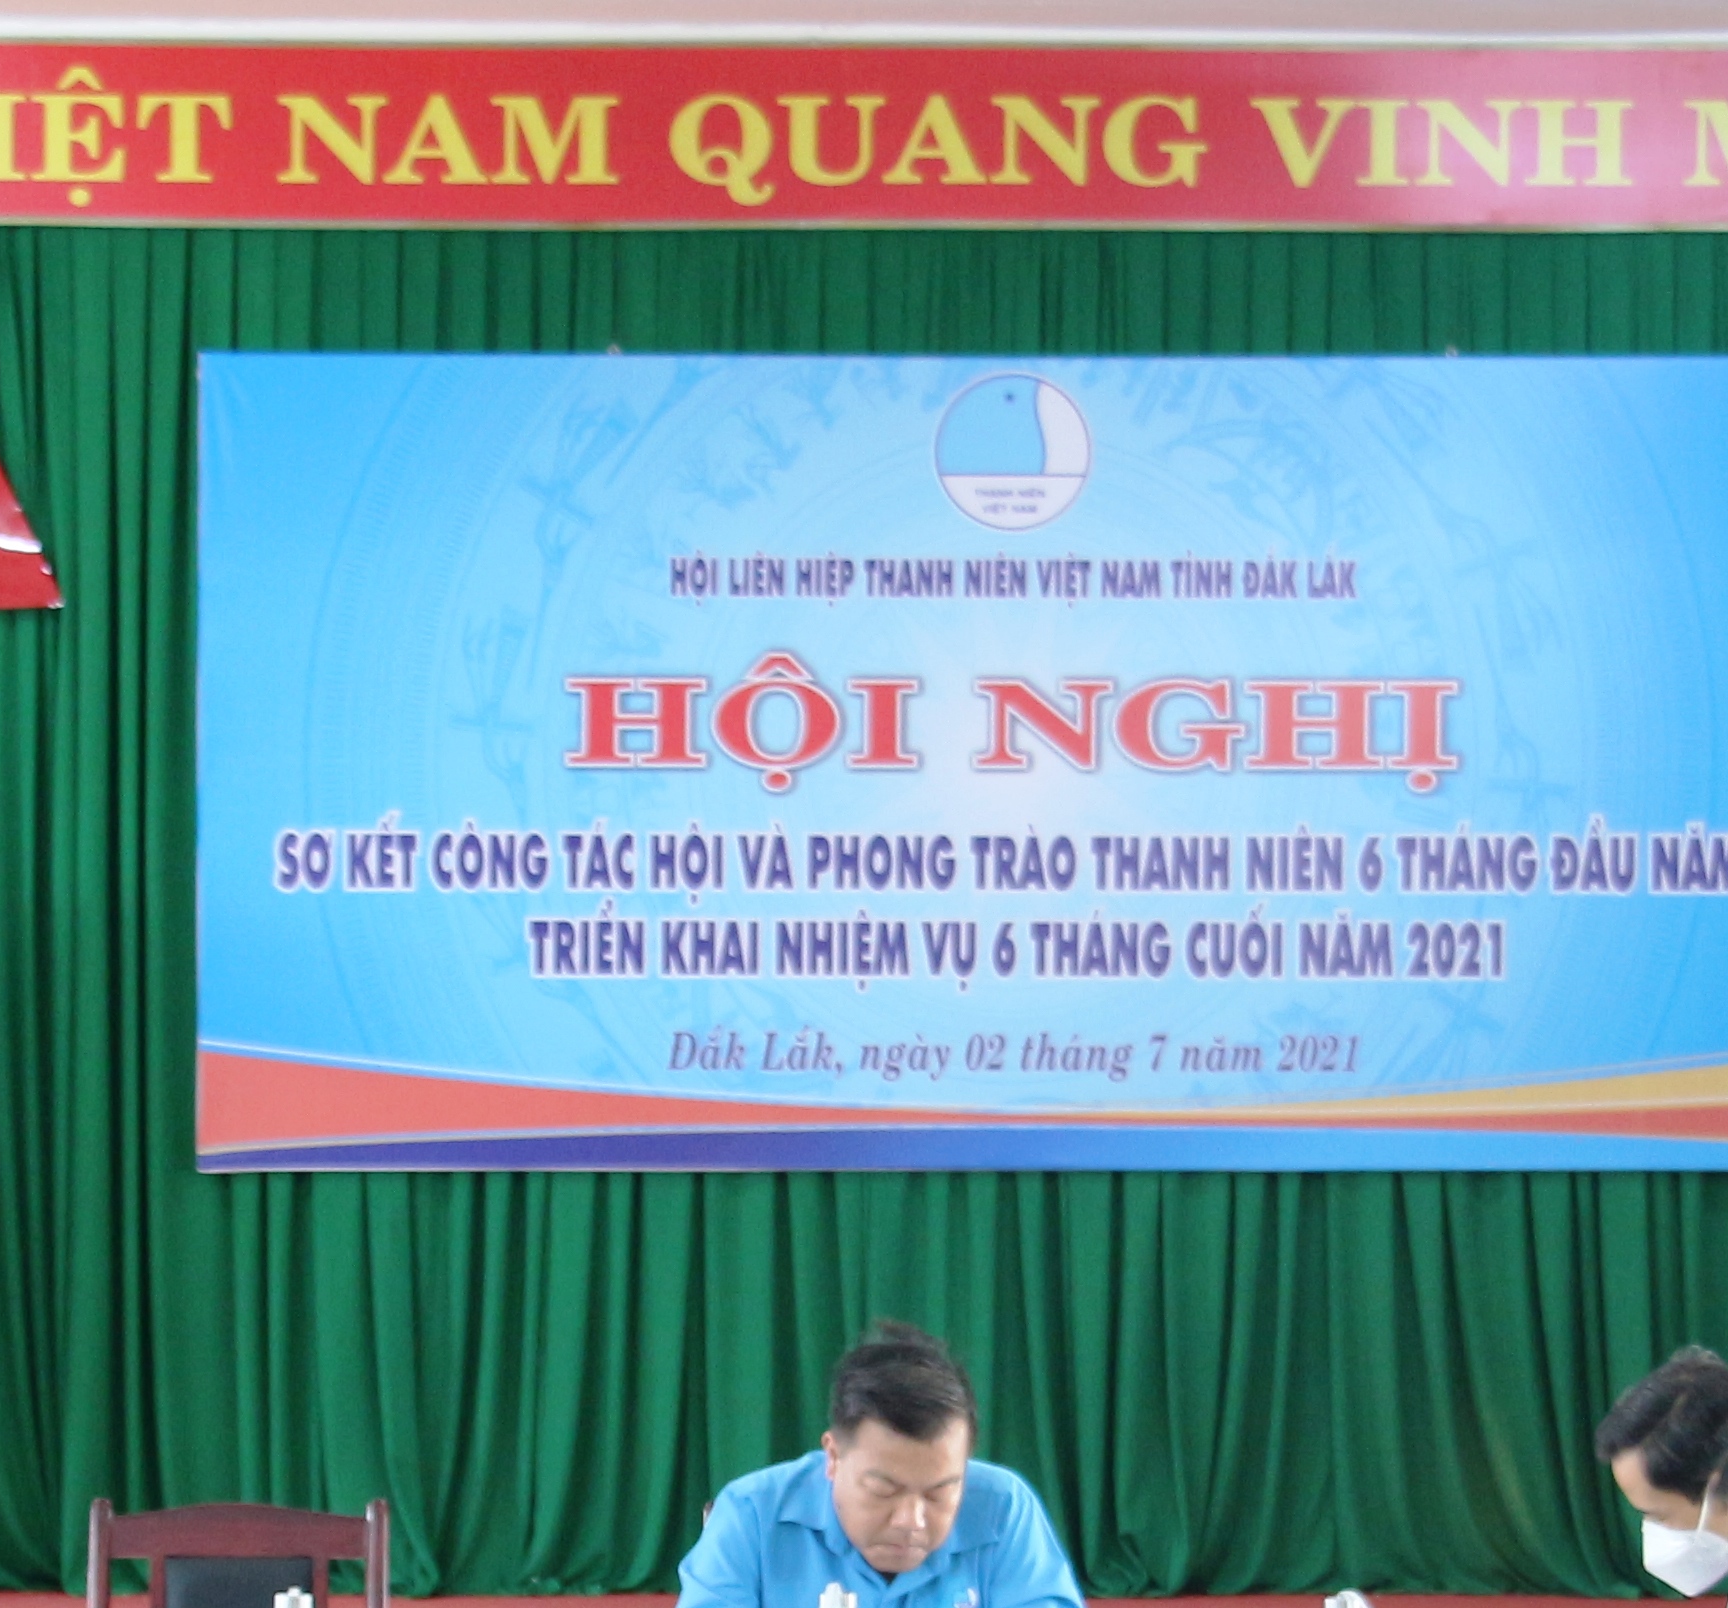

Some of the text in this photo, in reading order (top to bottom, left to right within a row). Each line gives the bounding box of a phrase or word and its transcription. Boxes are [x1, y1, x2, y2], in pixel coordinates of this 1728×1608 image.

[276, 91, 620, 186] NAM
[668, 94, 1208, 206] QUANG
[1251, 97, 1634, 189] VINH
[670, 549, 718, 607] HỘI
[728, 549, 785, 598] LIÊN
[795, 550, 855, 607] HIỆP
[863, 558, 954, 598] THANH
[965, 550, 1027, 598] NIÊN
[1036, 552, 1091, 608] VIỆT
[1101, 560, 1161, 599] NAM
[566, 653, 1458, 792] HỘI NGHỊ
[277, 830, 332, 891] SƠ
[346, 812, 417, 889] KẾT
[431, 820, 549, 891] CÔNG
[562, 819, 635, 890] TÁC
[649, 822, 724, 905] HỘI
[738, 822, 793, 890] VÀ
[807, 834, 956, 891] PHONG
[971, 823, 1075, 891] TRÀO
[1091, 835, 1230, 891] THANH
[1245, 824, 1344, 891] NIÊN
[1359, 835, 1383, 892] 6
[1396, 825, 1537, 892] THÁNG
[1551, 813, 1637, 892] ĐẦU
[529, 898, 1503, 990] TRIỂN KHAI NHIỆM VỤ 6 THÁNG CUỐI NĂM 2021
[860, 1034, 950, 1081] ngày
[965, 1033, 1006, 1071] 02
[1021, 1033, 1133, 1081] tháng
[1150, 1034, 1167, 1072] 7
[1180, 1036, 1263, 1072] năm
[1276, 1034, 1360, 1072] 2021
